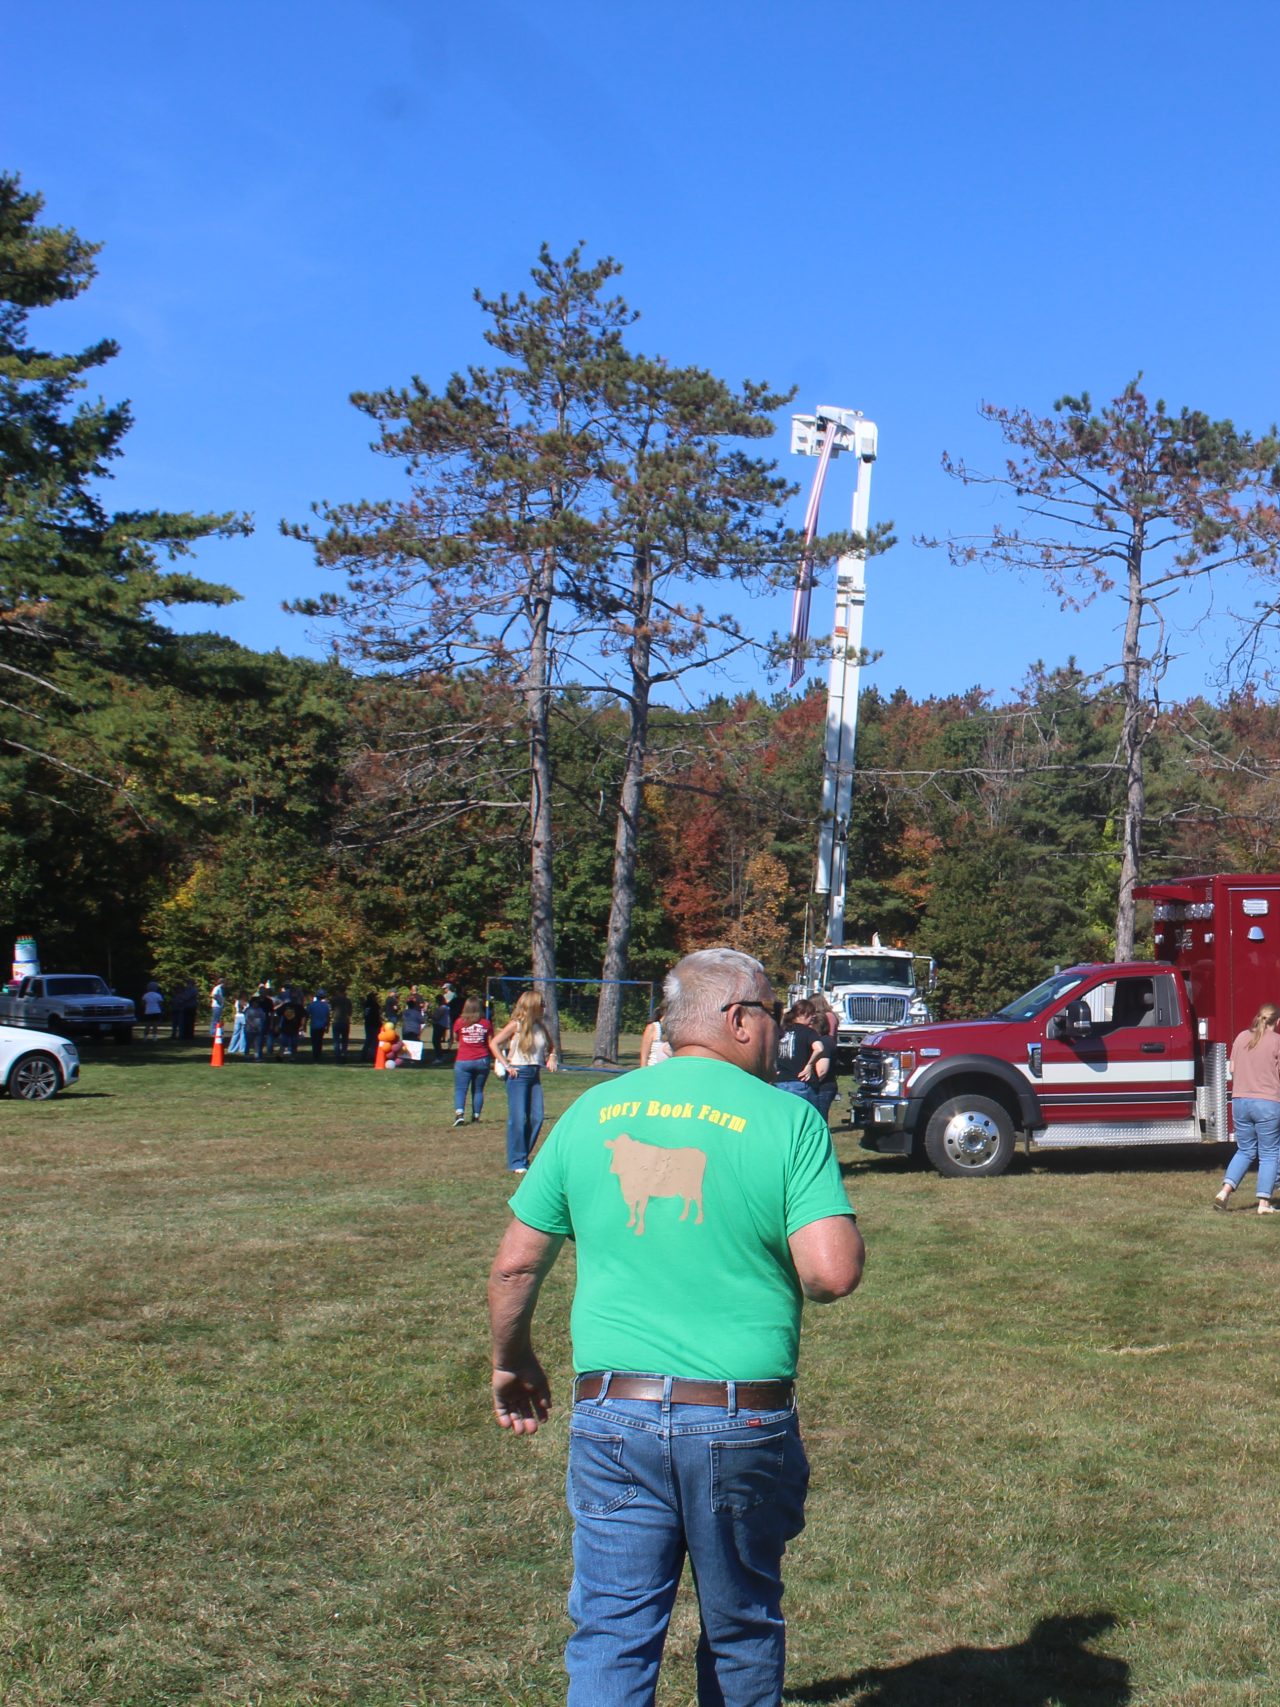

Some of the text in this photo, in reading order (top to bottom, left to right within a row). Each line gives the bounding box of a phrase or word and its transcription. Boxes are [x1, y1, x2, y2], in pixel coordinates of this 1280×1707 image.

[599, 1100, 747, 1133] Story Book Farm
